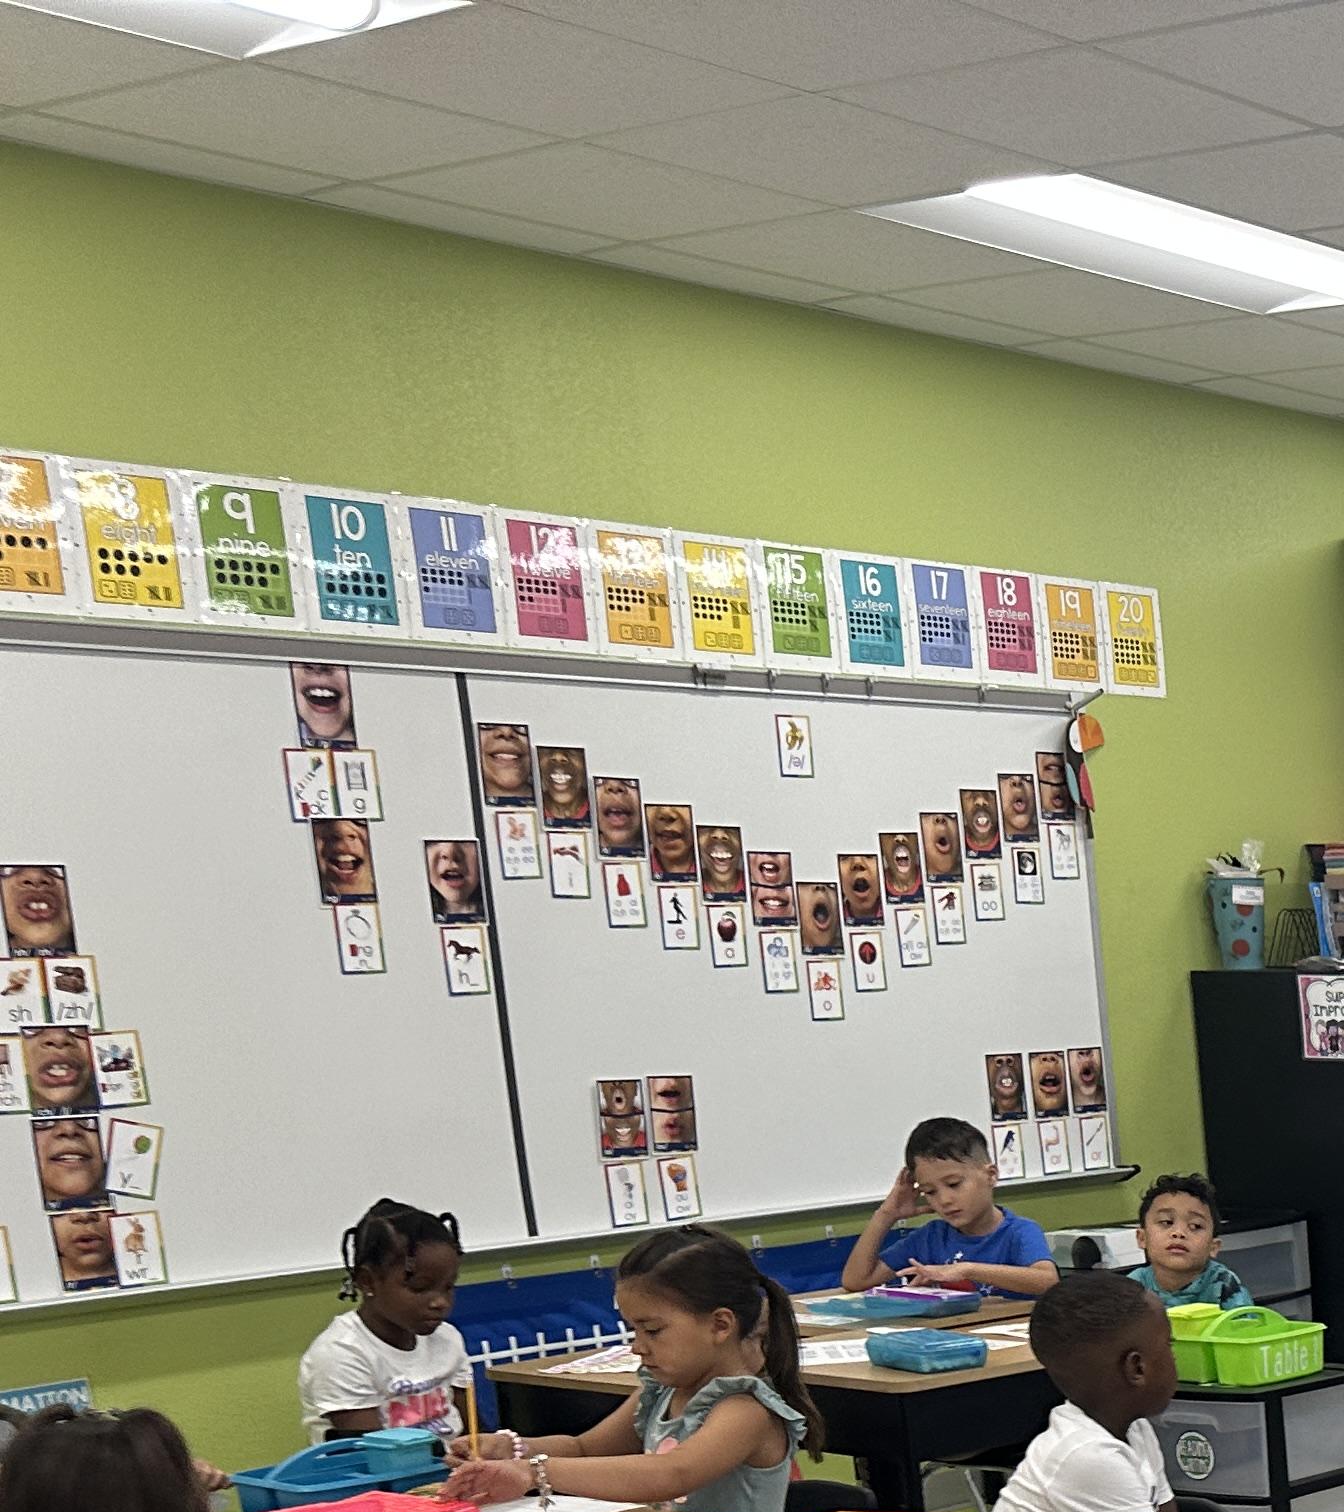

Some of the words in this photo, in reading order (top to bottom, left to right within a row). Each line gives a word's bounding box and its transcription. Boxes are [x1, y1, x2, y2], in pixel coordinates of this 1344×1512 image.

[222, 491, 256, 535] 9
[329, 502, 367, 542] 10
[101, 520, 158, 546] eight
[218, 537, 271, 556] nine
[440, 515, 459, 552] 11
[334, 543, 373, 570] ten
[425, 552, 480, 571] eleven
[782, 553, 807, 586] 15
[857, 564, 882, 597] 16
[929, 569, 949, 601] 17
[996, 576, 1018, 606] 18
[851, 599, 894, 612] sixteen
[918, 603, 968, 617] seventeen
[987, 607, 1031, 621] eighteen
[1059, 589, 1082, 618] 19
[1117, 595, 1144, 623] 20
[8, 1004, 33, 1023] sh
[1259, 1339, 1309, 1379] Table
[1312, 1335, 1319, 1365] 1
